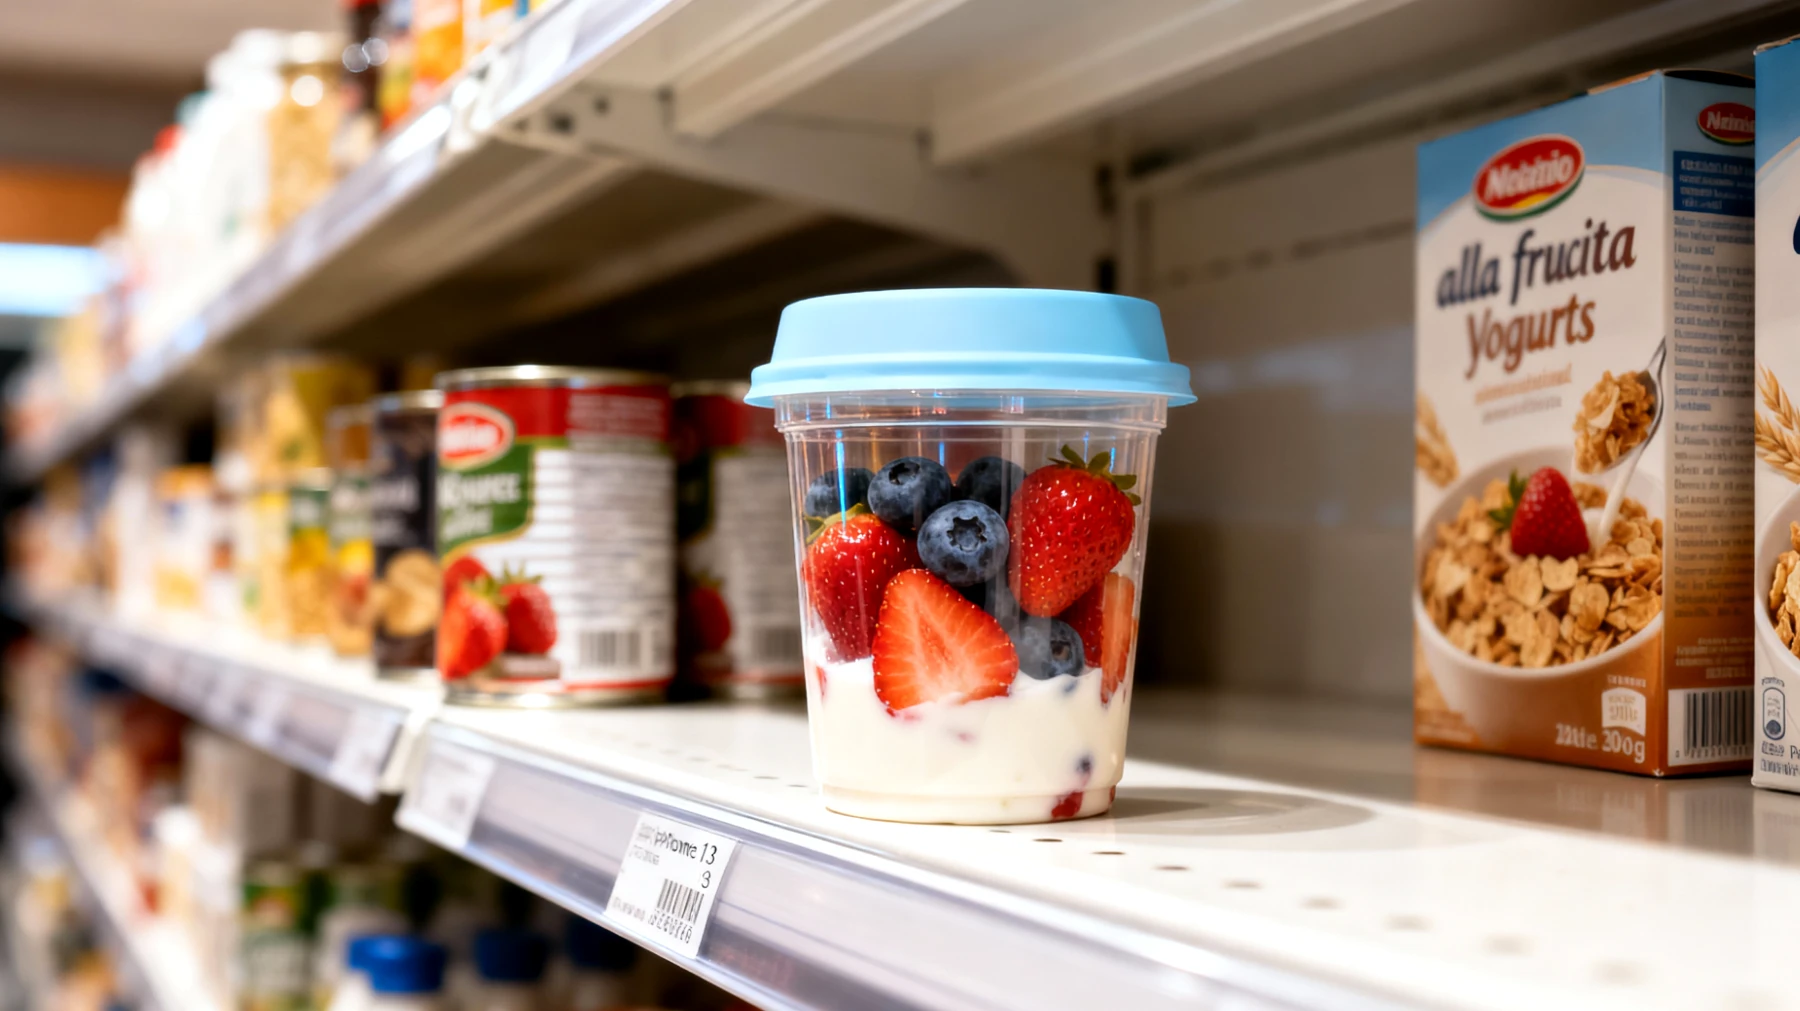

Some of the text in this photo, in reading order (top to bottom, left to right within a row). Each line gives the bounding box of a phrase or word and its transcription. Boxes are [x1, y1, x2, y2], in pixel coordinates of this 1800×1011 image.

[1436, 244, 1500, 308] alla
[1510, 218, 1637, 305] frucita
[1465, 294, 1597, 380] Yogurts
[700, 842, 718, 865] 13
